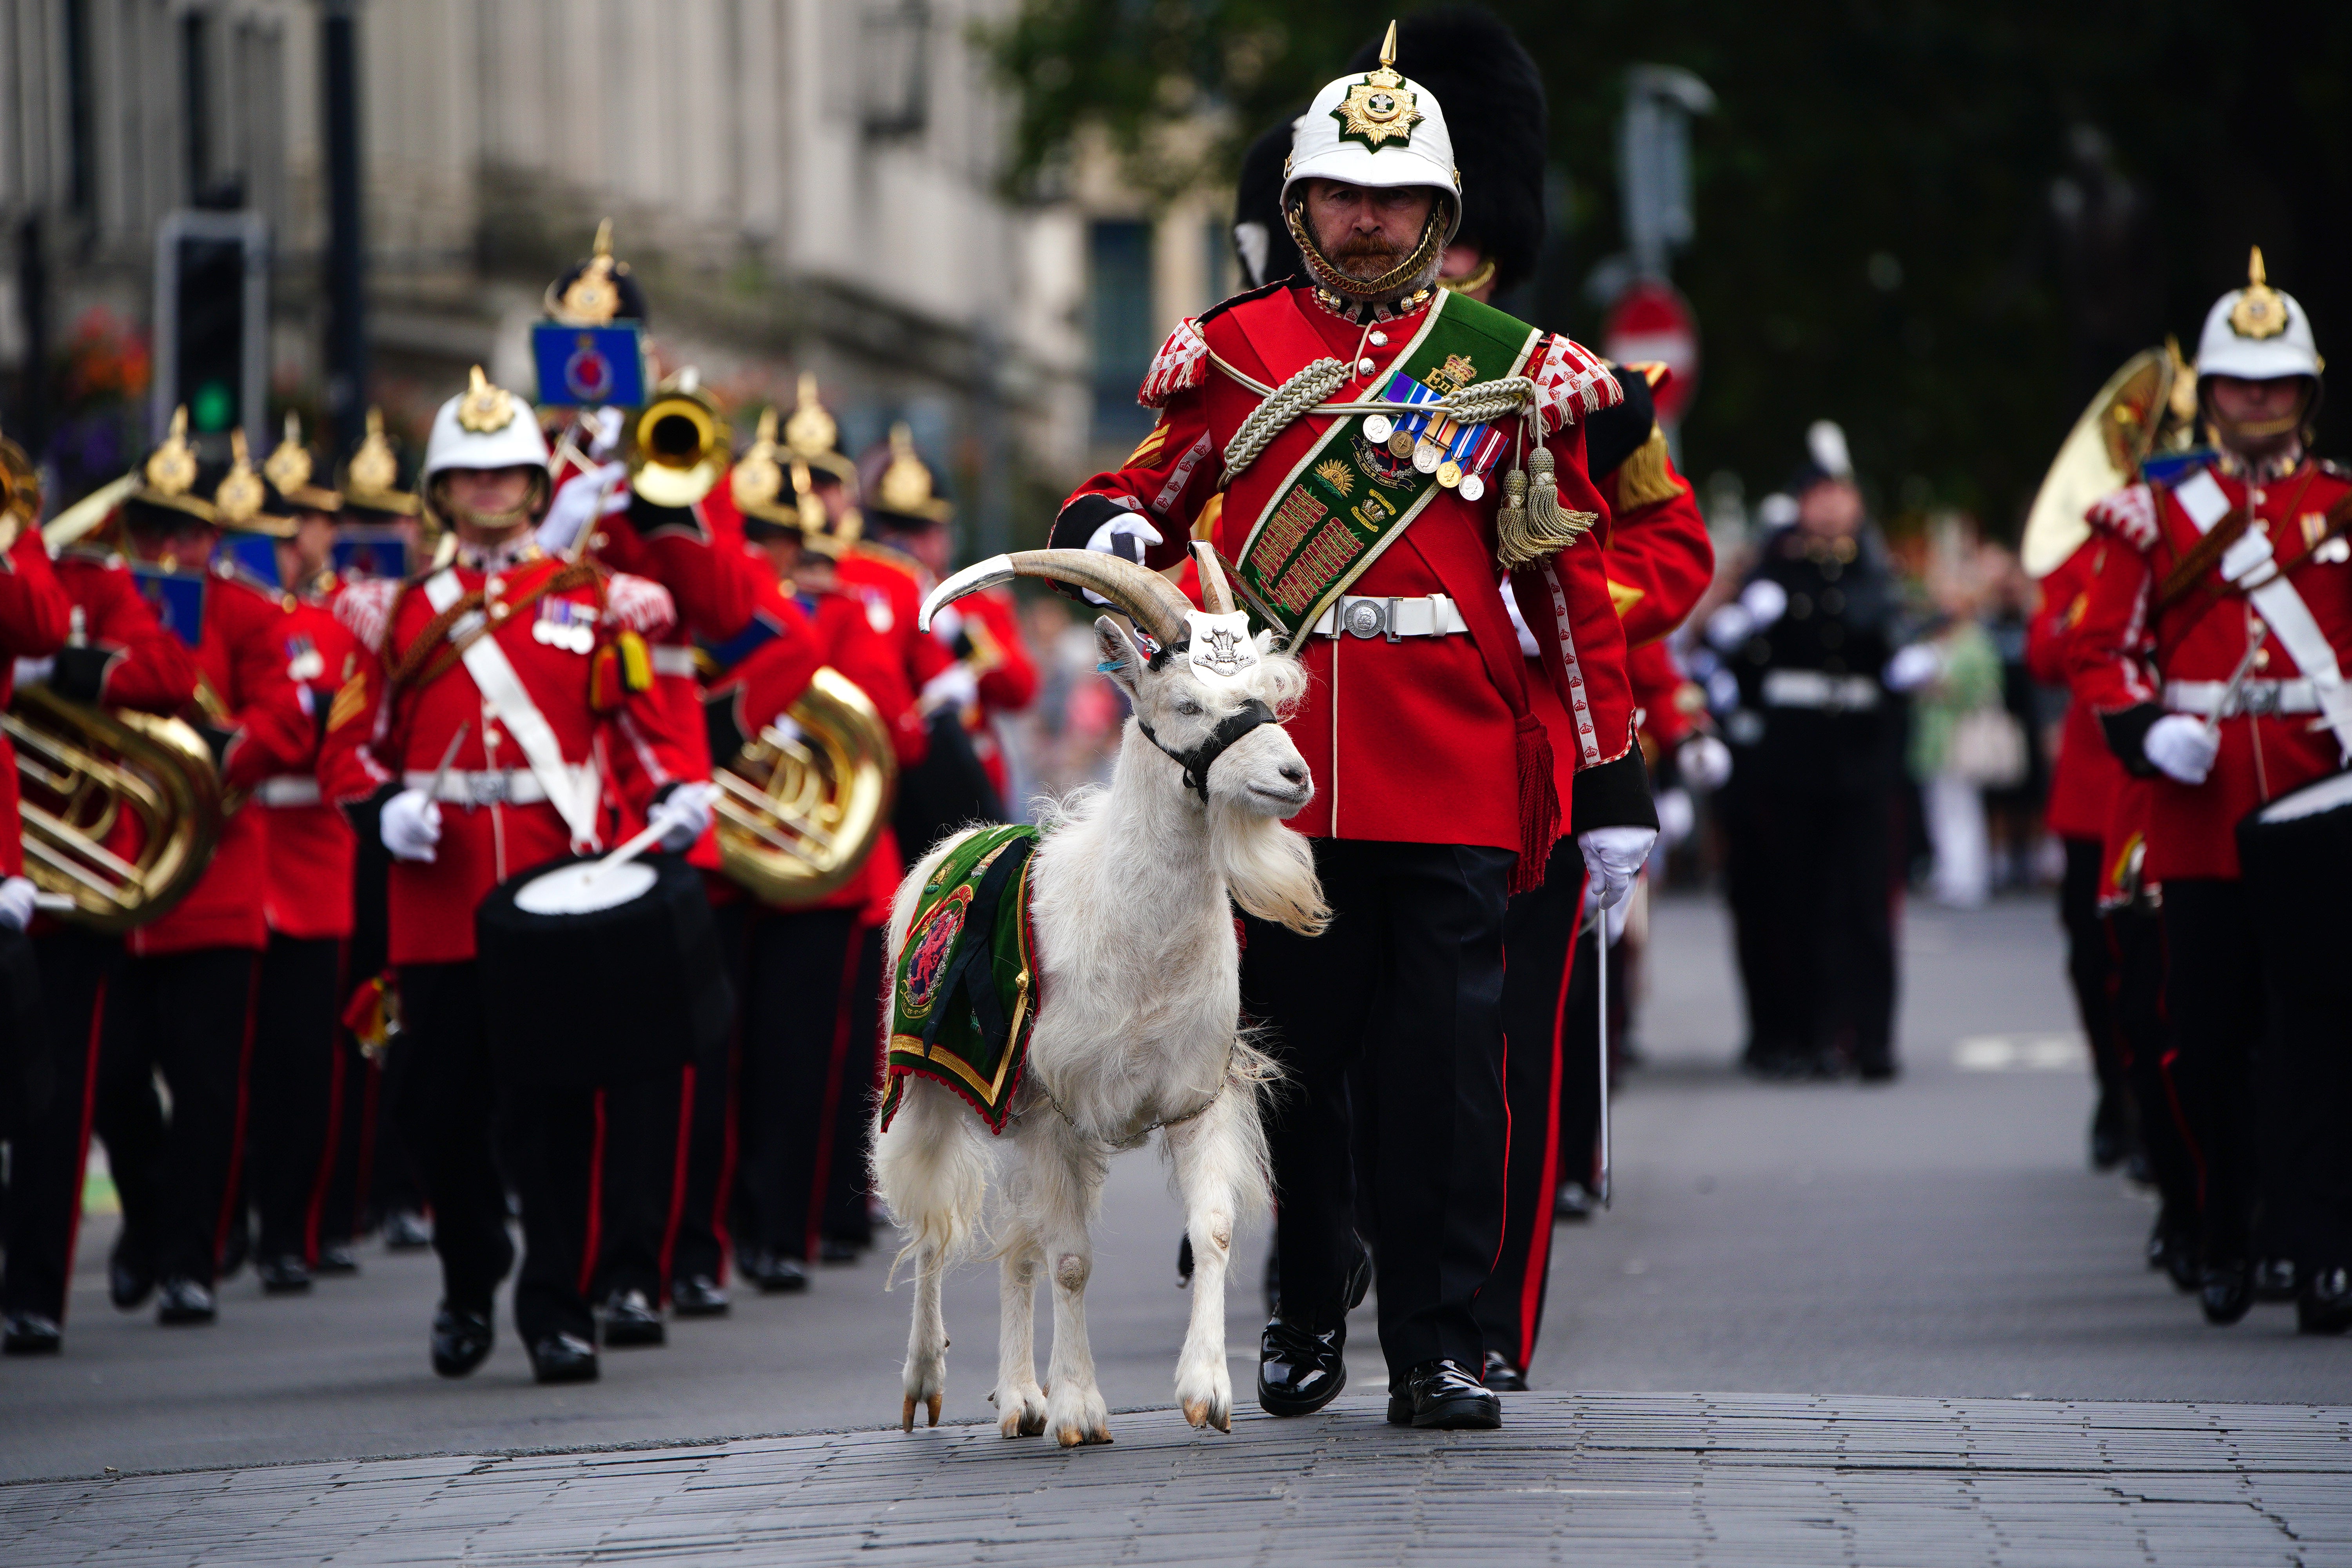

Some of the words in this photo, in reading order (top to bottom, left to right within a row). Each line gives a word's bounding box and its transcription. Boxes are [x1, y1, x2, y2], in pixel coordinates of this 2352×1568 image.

[1392, 94, 1400, 109] WELSH
[1376, 494, 1388, 506] APRIL
[1332, 530, 1351, 551] OUDENARDE
[1339, 525, 1356, 544] BLENHEIM
[1325, 537, 1343, 557] DETTINGEN
[1316, 553, 1327, 564] INDIA
[1292, 566, 1305, 581] FUENTES
[1302, 564, 1317, 581] BOURBON
[1308, 559, 1324, 575] CORUNNA
[1295, 583, 1303, 592] JAVA
